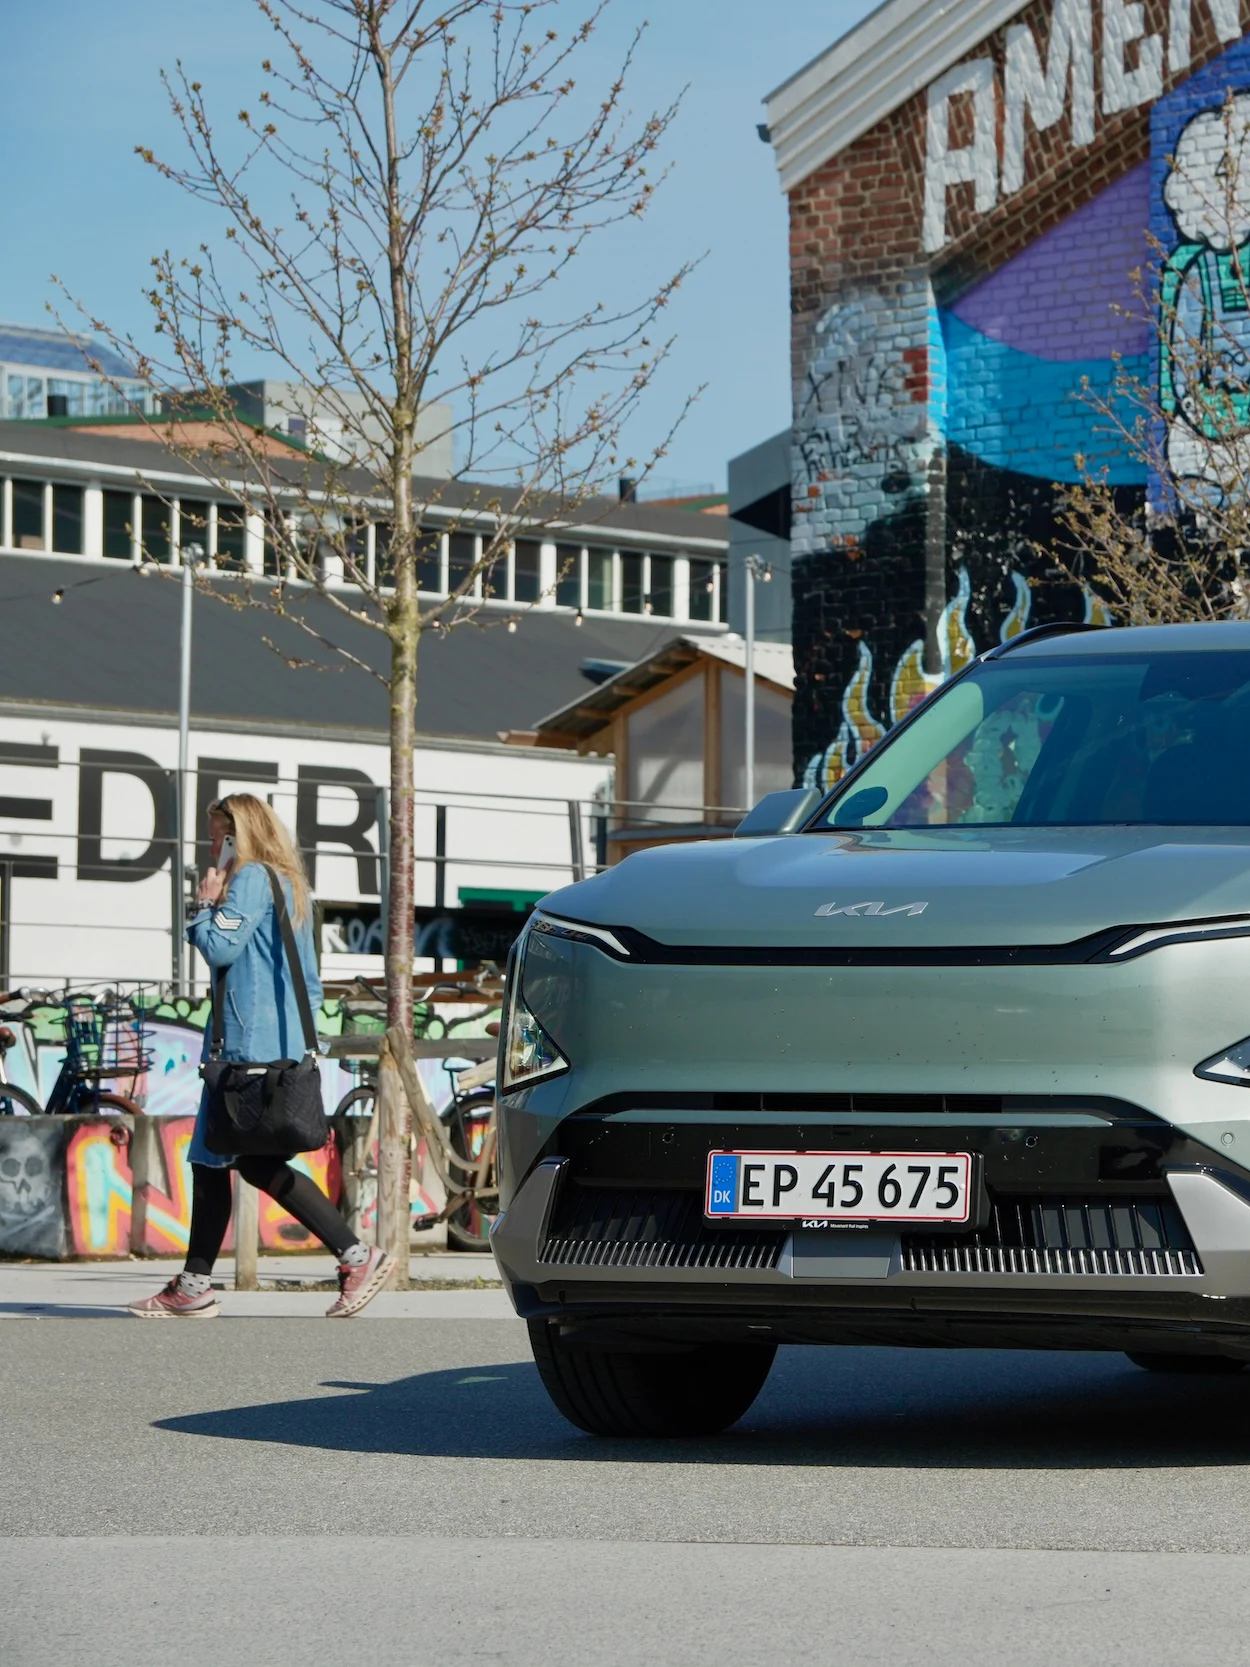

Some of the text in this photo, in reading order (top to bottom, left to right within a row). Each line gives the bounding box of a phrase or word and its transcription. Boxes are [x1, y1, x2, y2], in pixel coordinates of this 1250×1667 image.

[814, 902, 929, 917] KIA
[742, 1163, 959, 1209] EP 45 675
[713, 1190, 731, 1204] DK
[802, 1219, 829, 1229] KIA
